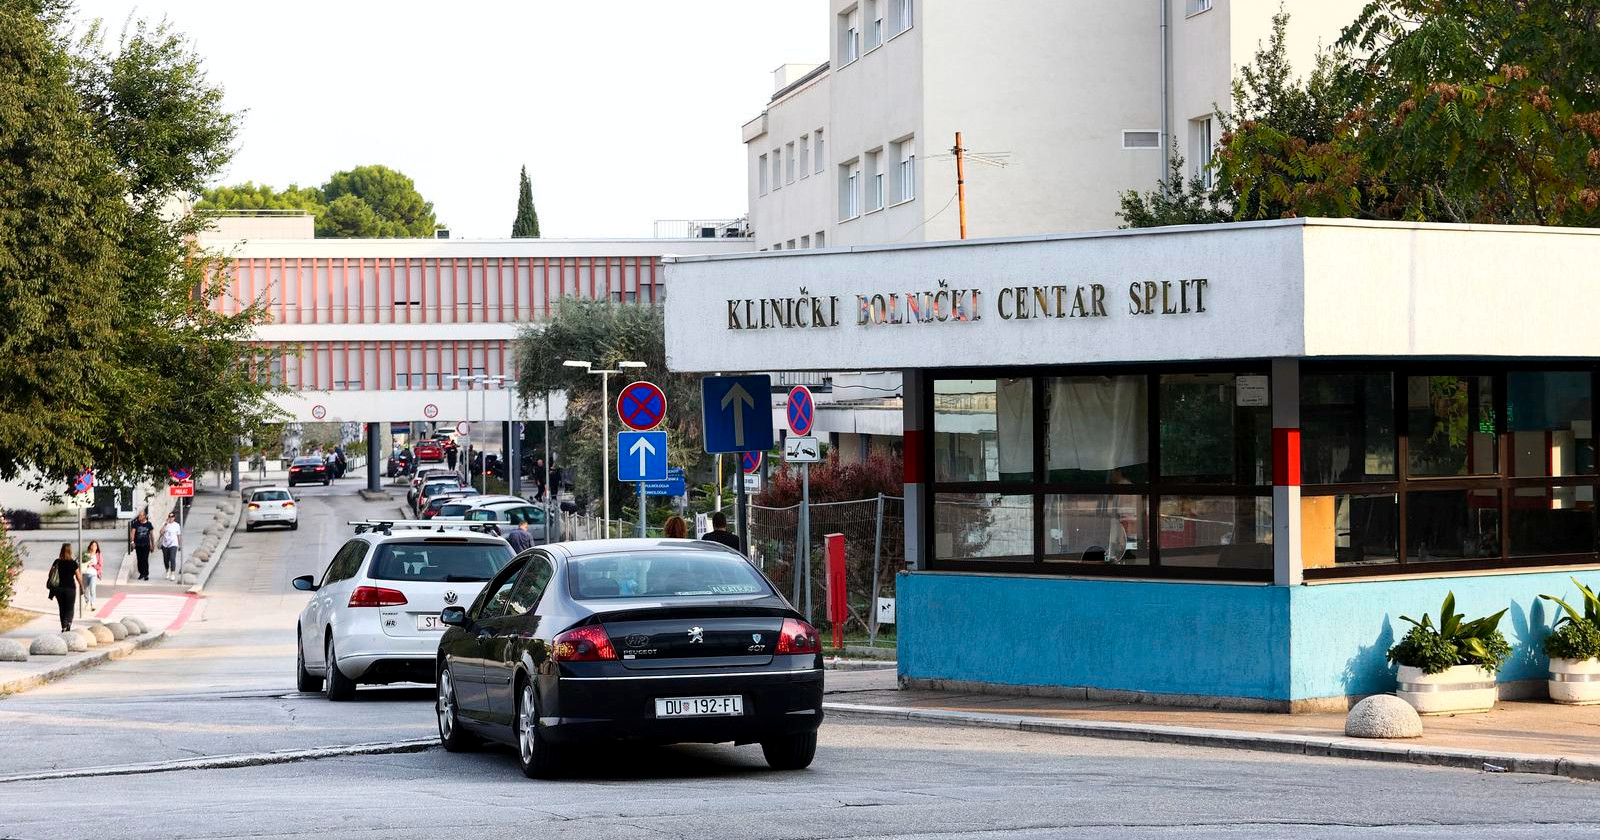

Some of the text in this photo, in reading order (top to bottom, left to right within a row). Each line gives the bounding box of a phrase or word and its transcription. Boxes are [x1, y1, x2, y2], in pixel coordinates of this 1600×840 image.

[727, 278, 1209, 330] KLINIČKI BOLNIČKI CENTAR SPLIT
[426, 616, 438, 628] ST
[666, 698, 740, 714] DU 192-FL
